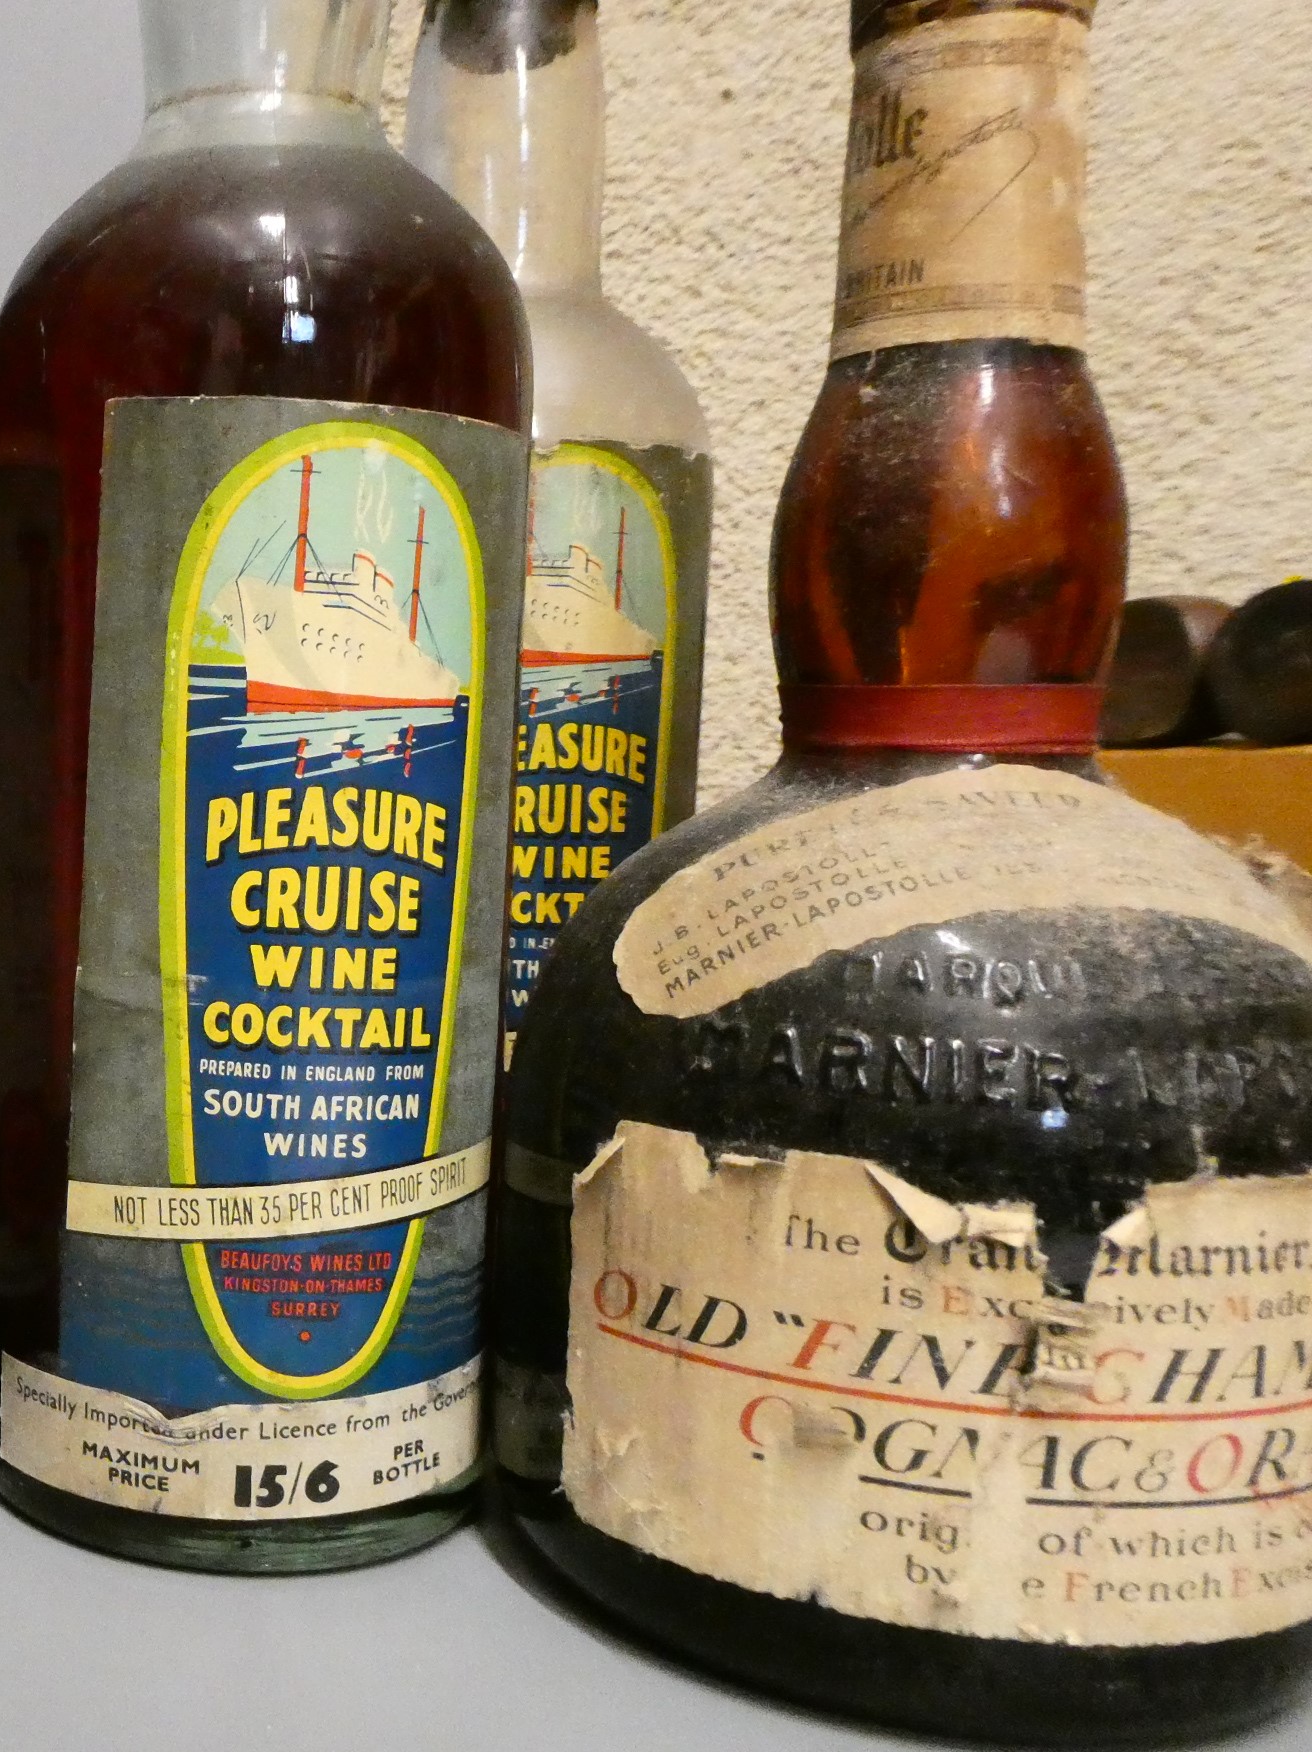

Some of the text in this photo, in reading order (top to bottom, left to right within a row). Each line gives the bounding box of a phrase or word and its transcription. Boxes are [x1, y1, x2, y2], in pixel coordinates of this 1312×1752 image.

[517, 722, 647, 784] EASURE
[204, 785, 448, 869] PLEASURE
[514, 784, 627, 834] RUISE
[513, 846, 611, 879] WINE
[707, 840, 890, 921] LAPOSTOLL
[230, 866, 421, 934] CRUISE
[716, 859, 907, 938] LAPOSTOLLE
[249, 944, 398, 992] WINE
[202, 1000, 432, 1049] COCKTAIL
[199, 1058, 425, 1082] PREPARED IN ENGLAND FROM
[203, 1088, 420, 1121] SOUTH AFRICAN
[264, 1132, 368, 1159] WINES
[113, 1156, 468, 1227] NOT LESS THAN 35 PER CENT PROOF SPIRIT
[310, 1253, 364, 1273] WINES
[368, 1252, 393, 1271] LTD
[271, 1301, 341, 1318] SURREY
[593, 1269, 748, 1348] OLD
[881, 1274, 924, 1311] is
[16, 1376, 77, 1421] Specially
[185, 1421, 249, 1440] under
[259, 1420, 338, 1440] Licence
[346, 1413, 390, 1433] from
[402, 1403, 427, 1422] the
[82, 1440, 201, 1475] MAXIMUM
[373, 1451, 441, 1486] BOTTLE
[393, 1439, 425, 1461] PER
[108, 1467, 170, 1492] PRICE
[233, 1459, 341, 1509] 15/6
[1134, 1449, 1175, 1493] &
[1038, 1526, 1093, 1556] of
[1110, 1526, 1237, 1557] which
[1254, 1520, 1284, 1550] is
[1064, 1571, 1222, 1602] French
